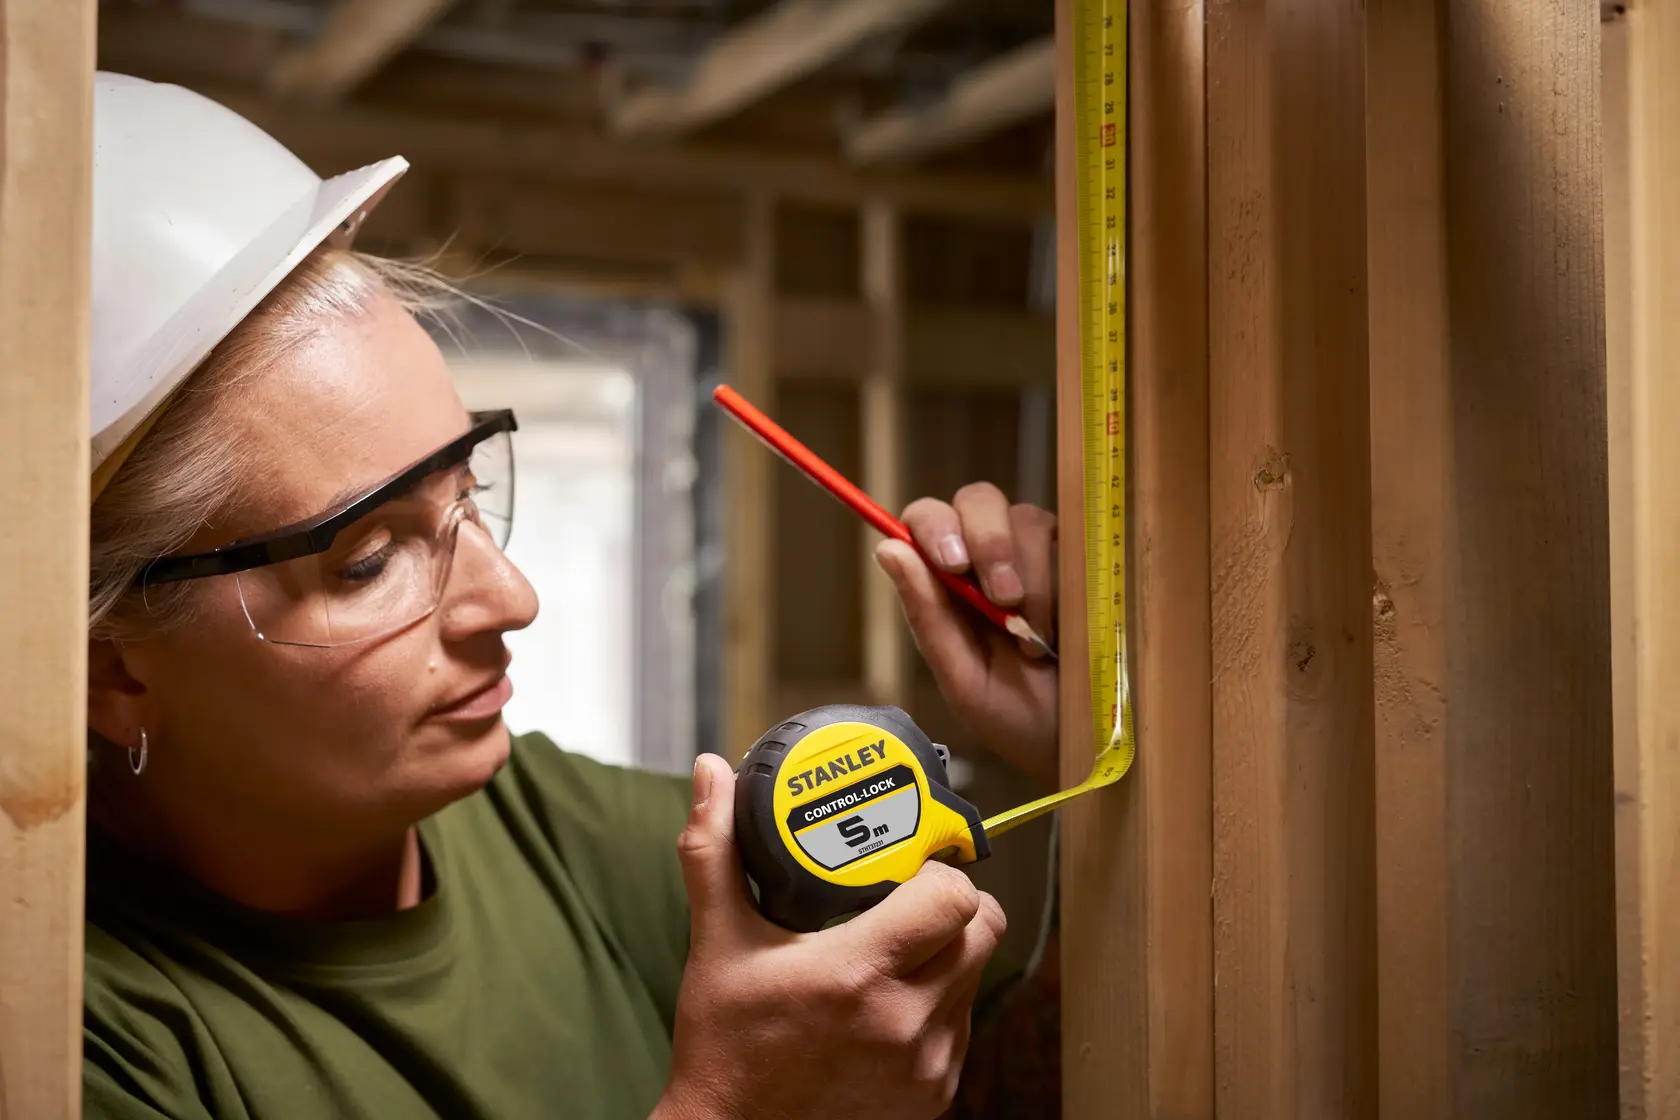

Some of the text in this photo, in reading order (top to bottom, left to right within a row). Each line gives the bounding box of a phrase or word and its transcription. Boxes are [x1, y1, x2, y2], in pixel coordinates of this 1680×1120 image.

[1106, 159, 1115, 170] 31
[1106, 186, 1115, 200] 32
[1107, 215, 1115, 229] 33
[1108, 302, 1117, 316] 36
[1109, 330, 1118, 343] 37
[1112, 447, 1119, 458] 41
[1112, 475, 1120, 489] 42
[1112, 504, 1120, 518] 43
[1112, 533, 1121, 547] 44
[1113, 562, 1121, 576] 45
[1113, 592, 1121, 606] 46
[787, 739, 887, 797] STANLEY
[804, 777, 896, 822] CONTROL-LOCK
